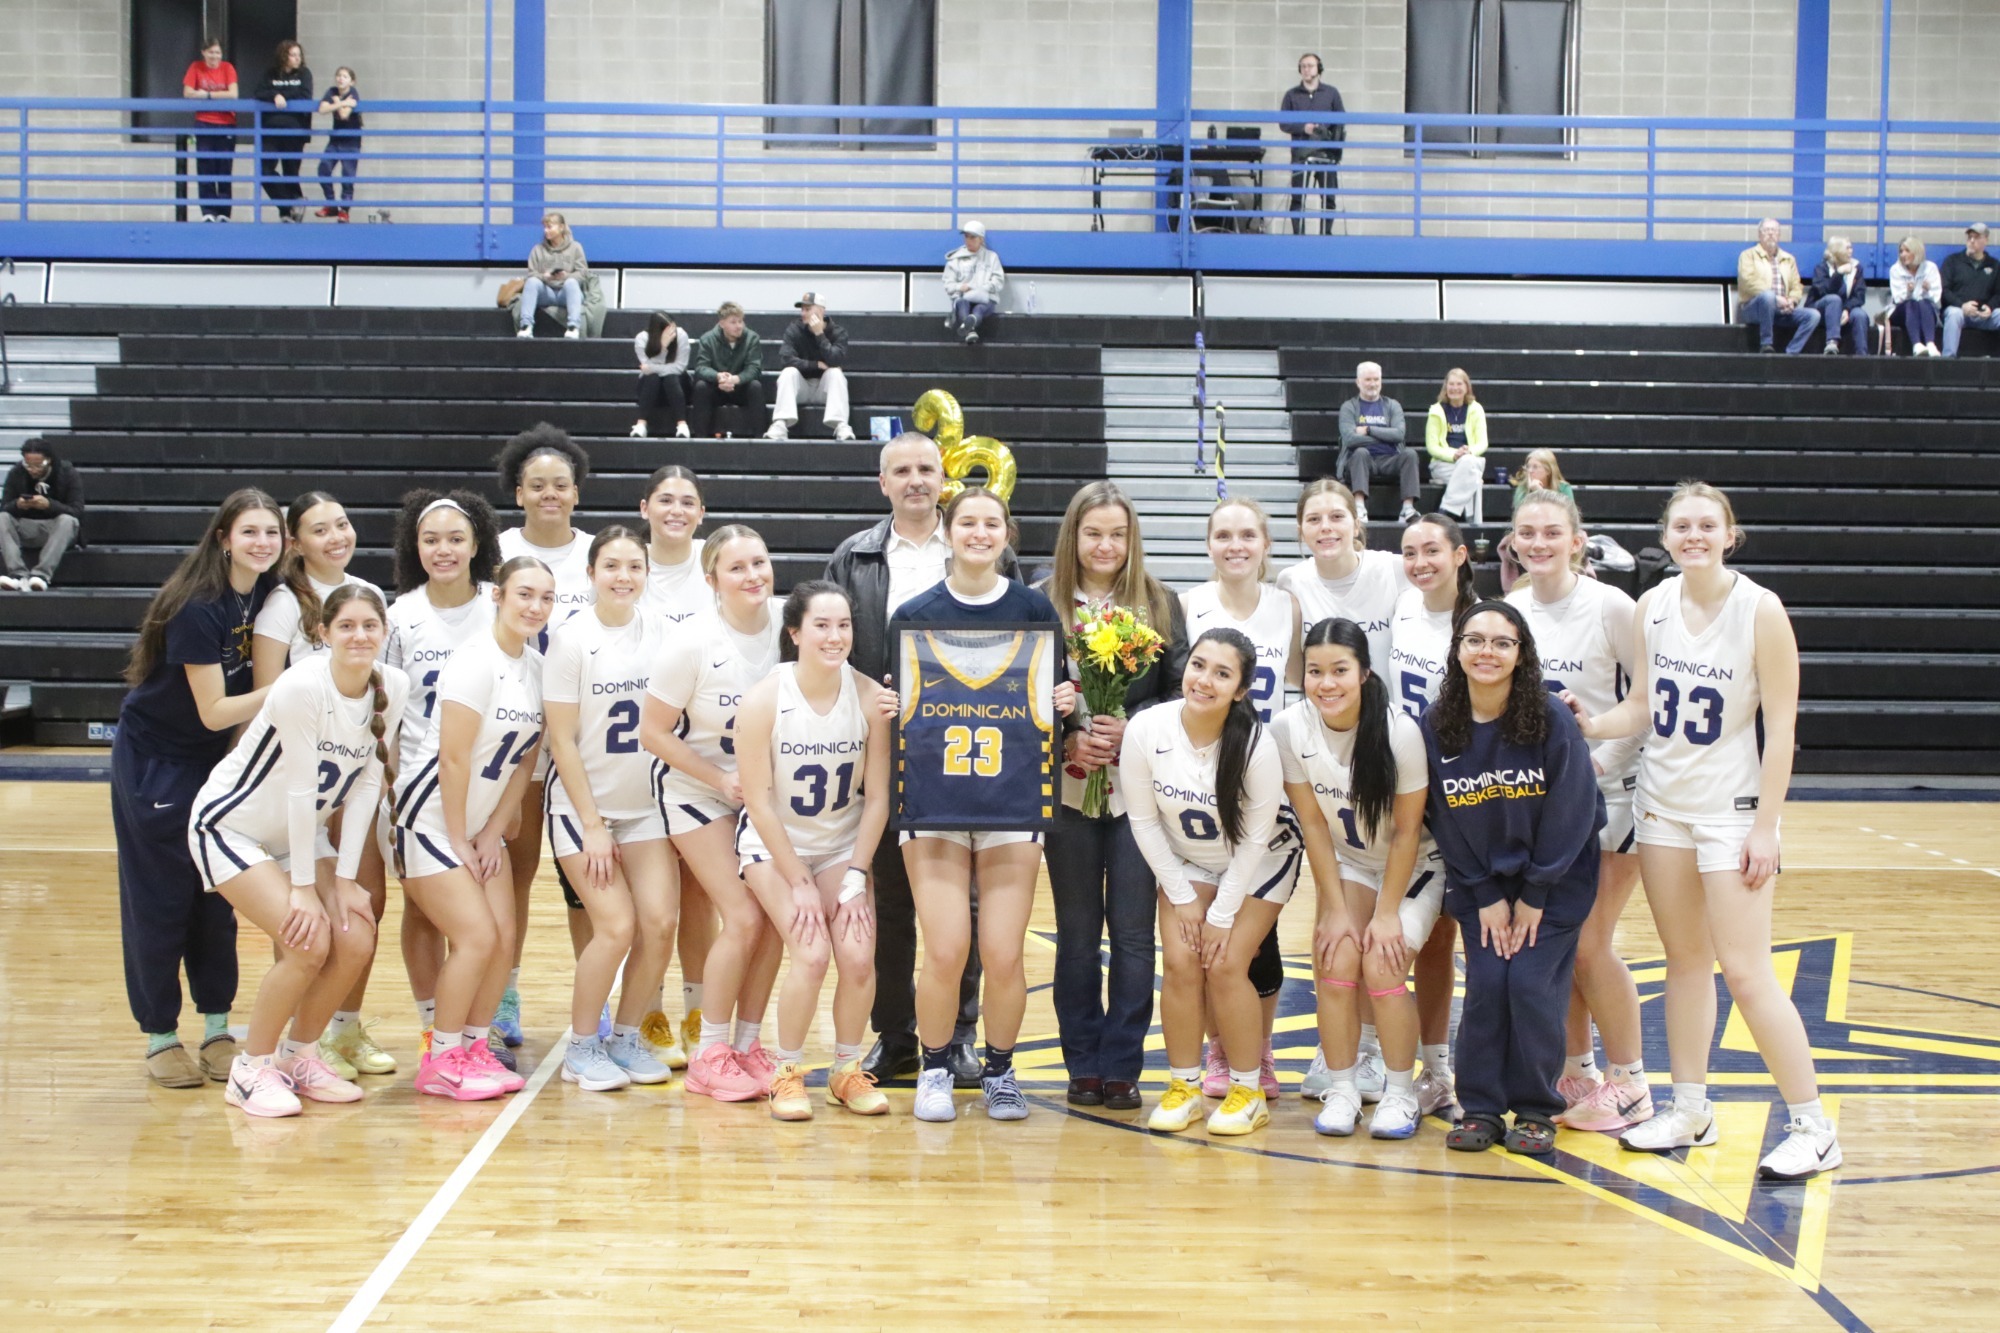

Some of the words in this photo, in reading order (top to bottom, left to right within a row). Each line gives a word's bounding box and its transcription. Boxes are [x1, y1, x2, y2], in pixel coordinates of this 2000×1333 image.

[1390, 648, 1448, 678] OMINICA
[592, 677, 650, 695] DOMINIC
[1246, 666, 1276, 723] 2
[1401, 670, 1429, 725] 5
[496, 708, 542, 724] DOMINIC
[606, 699, 640, 754] 2
[922, 703, 1026, 719] DOMINICAN
[1653, 677, 1724, 746] 33
[943, 725, 1003, 777] 23
[790, 762, 854, 817] 31
[1153, 780, 1218, 806] DOMINIC
[1443, 768, 1545, 795] DOMINICAN
[1446, 784, 1547, 808] BASKETBALL
[1179, 808, 1220, 840] 0
[1337, 807, 1366, 850] 1
